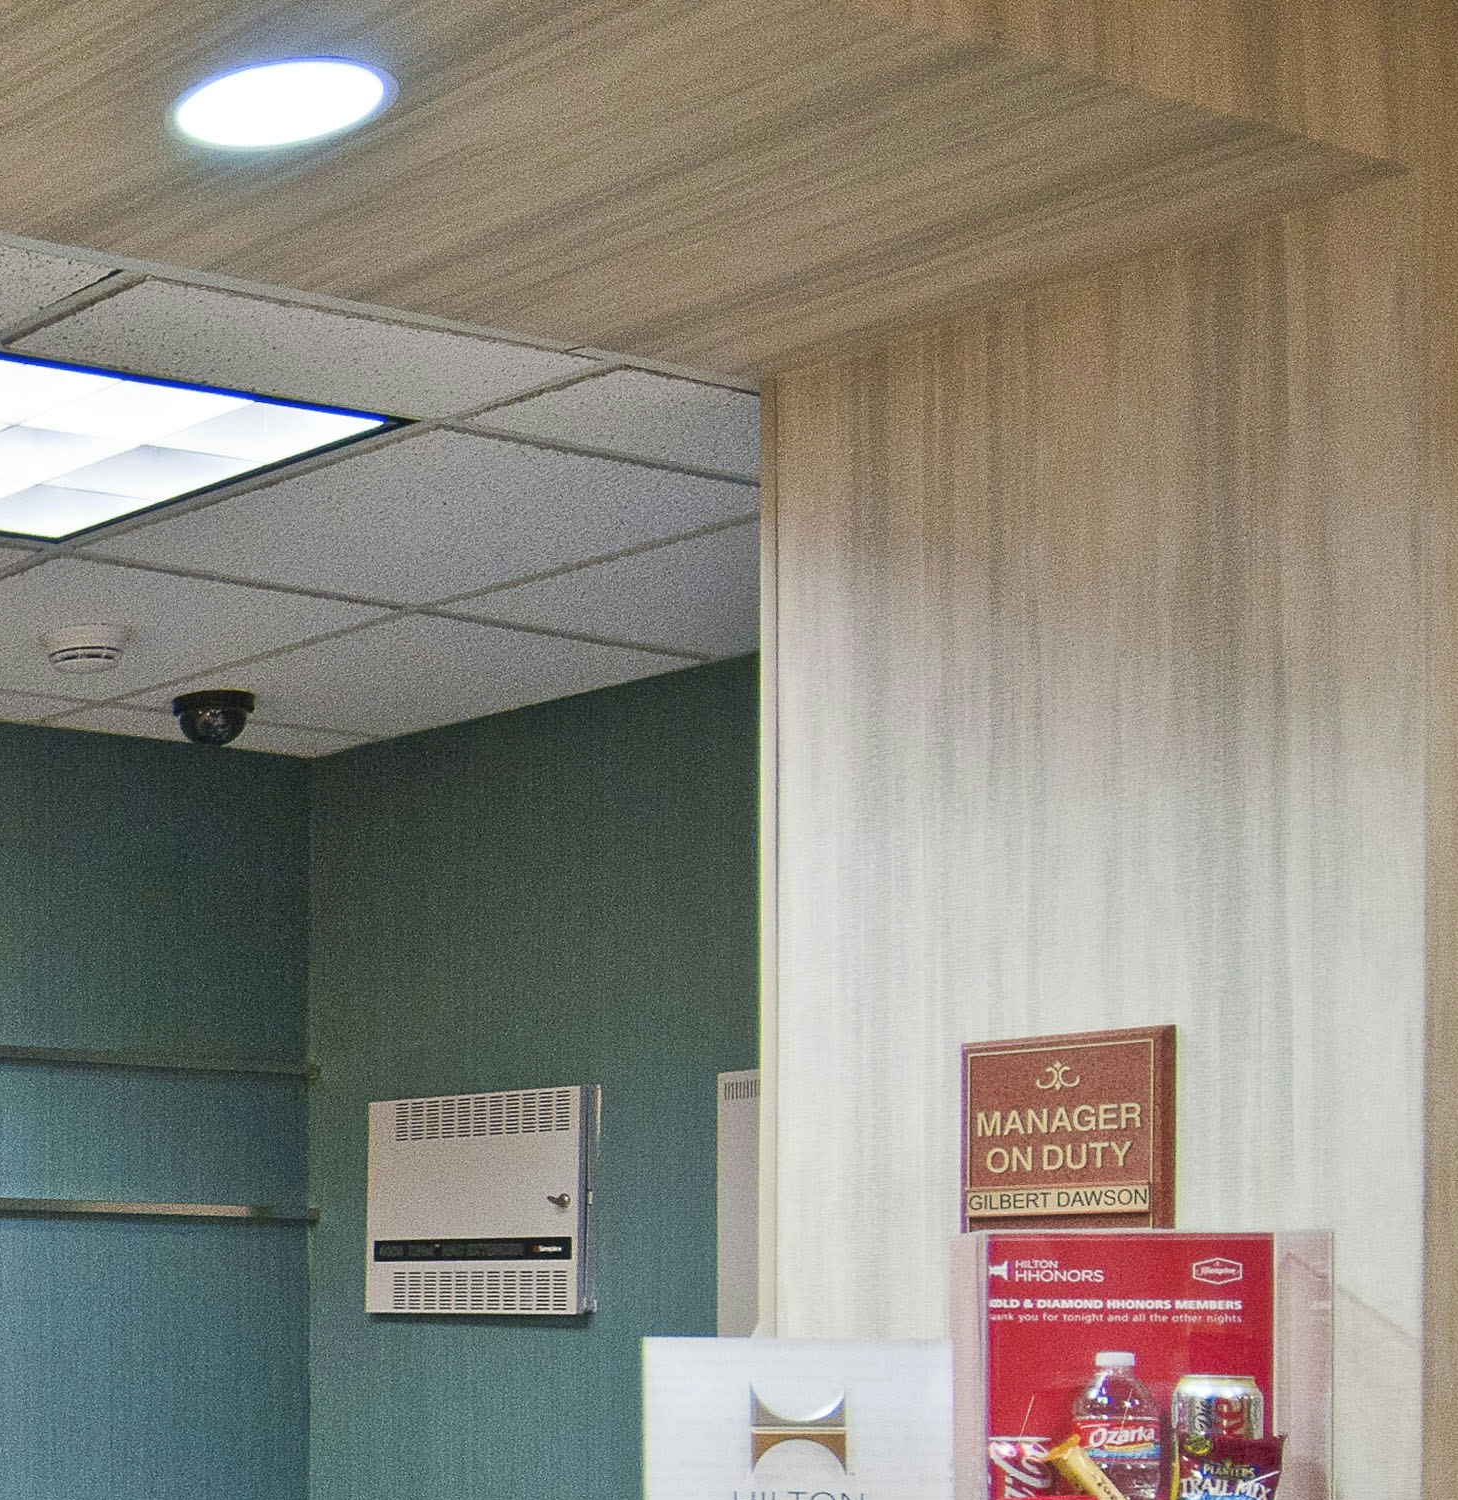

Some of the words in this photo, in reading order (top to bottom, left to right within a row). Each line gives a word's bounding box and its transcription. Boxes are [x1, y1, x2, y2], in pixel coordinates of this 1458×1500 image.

[976, 1103, 1141, 1137] MANAGER
[986, 1147, 1032, 1173] ON
[1043, 1140, 1132, 1171] DUTY
[969, 1192, 1051, 1210] GILBERT
[1057, 1189, 1148, 1207] DAWSON
[1015, 1260, 1058, 1269] HILTON
[1015, 1269, 1104, 1282] HHONORS
[1023, 1300, 1033, 1309] &
[1037, 1300, 1103, 1309] DIAMOND
[1107, 1300, 1172, 1309] HHONORS
[1175, 1300, 1242, 1310] MEMBERS
[1019, 1314, 1039, 1323] you
[1043, 1313, 1058, 1321] for
[1063, 1313, 1104, 1323] tonight
[1107, 1314, 1128, 1322] and
[1132, 1313, 1146, 1322] all
[1150, 1313, 1167, 1322] the
[1172, 1314, 1202, 1322] other
[1206, 1314, 1242, 1323] nights
[1089, 1424, 1155, 1447] Ozarka
[1180, 1477, 1233, 1499] TRAIL
